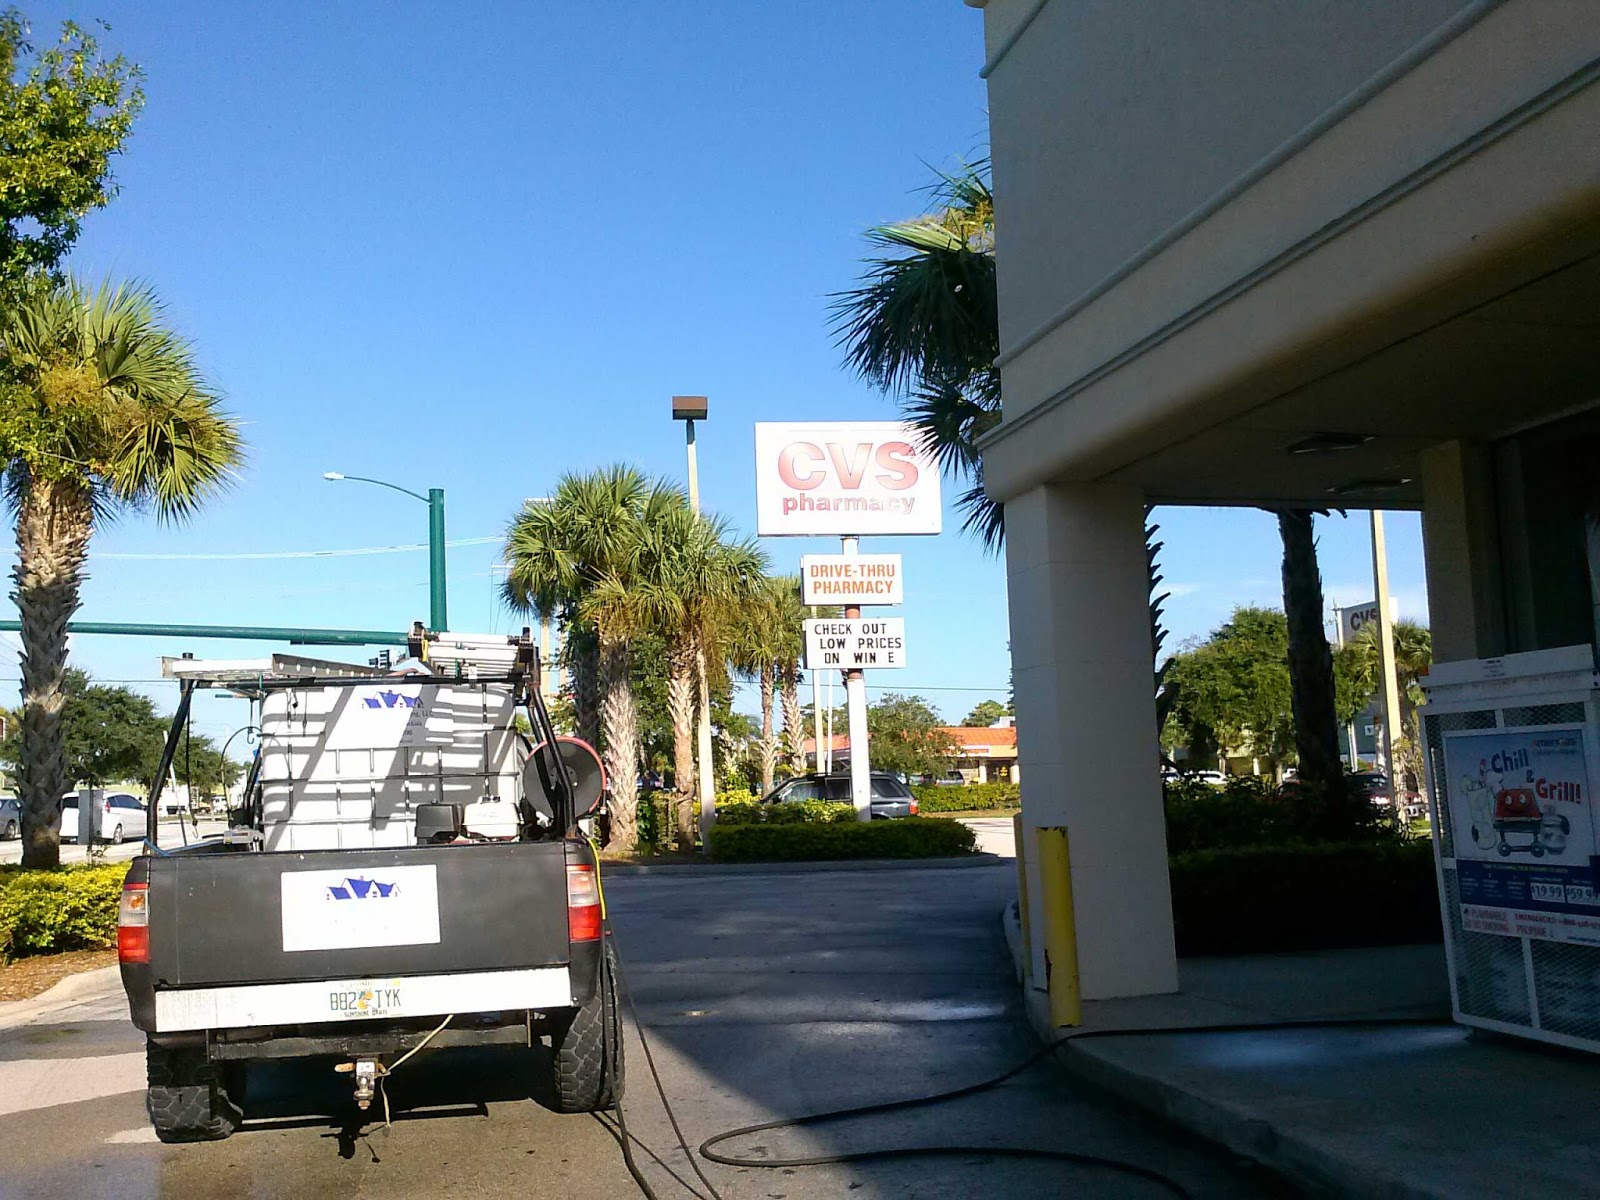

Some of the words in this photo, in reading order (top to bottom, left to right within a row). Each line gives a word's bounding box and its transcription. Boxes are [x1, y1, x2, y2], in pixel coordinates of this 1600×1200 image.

[778, 441, 918, 490] CVS
[783, 493, 916, 516] pharmacy
[810, 564, 896, 579] DRIVE-THRU
[813, 580, 893, 595] PHARMACY
[814, 623, 852, 635] CHECK
[862, 623, 887, 635] OUT
[820, 638, 846, 649] LOW
[858, 637, 902, 649] PRICES
[824, 652, 840, 664] ON
[1491, 748, 1530, 774] Chill
[1526, 769, 1535, 783] &
[1535, 778, 1581, 805] Grill!
[330, 991, 357, 1011] 882
[375, 988, 401, 1008] TYK
